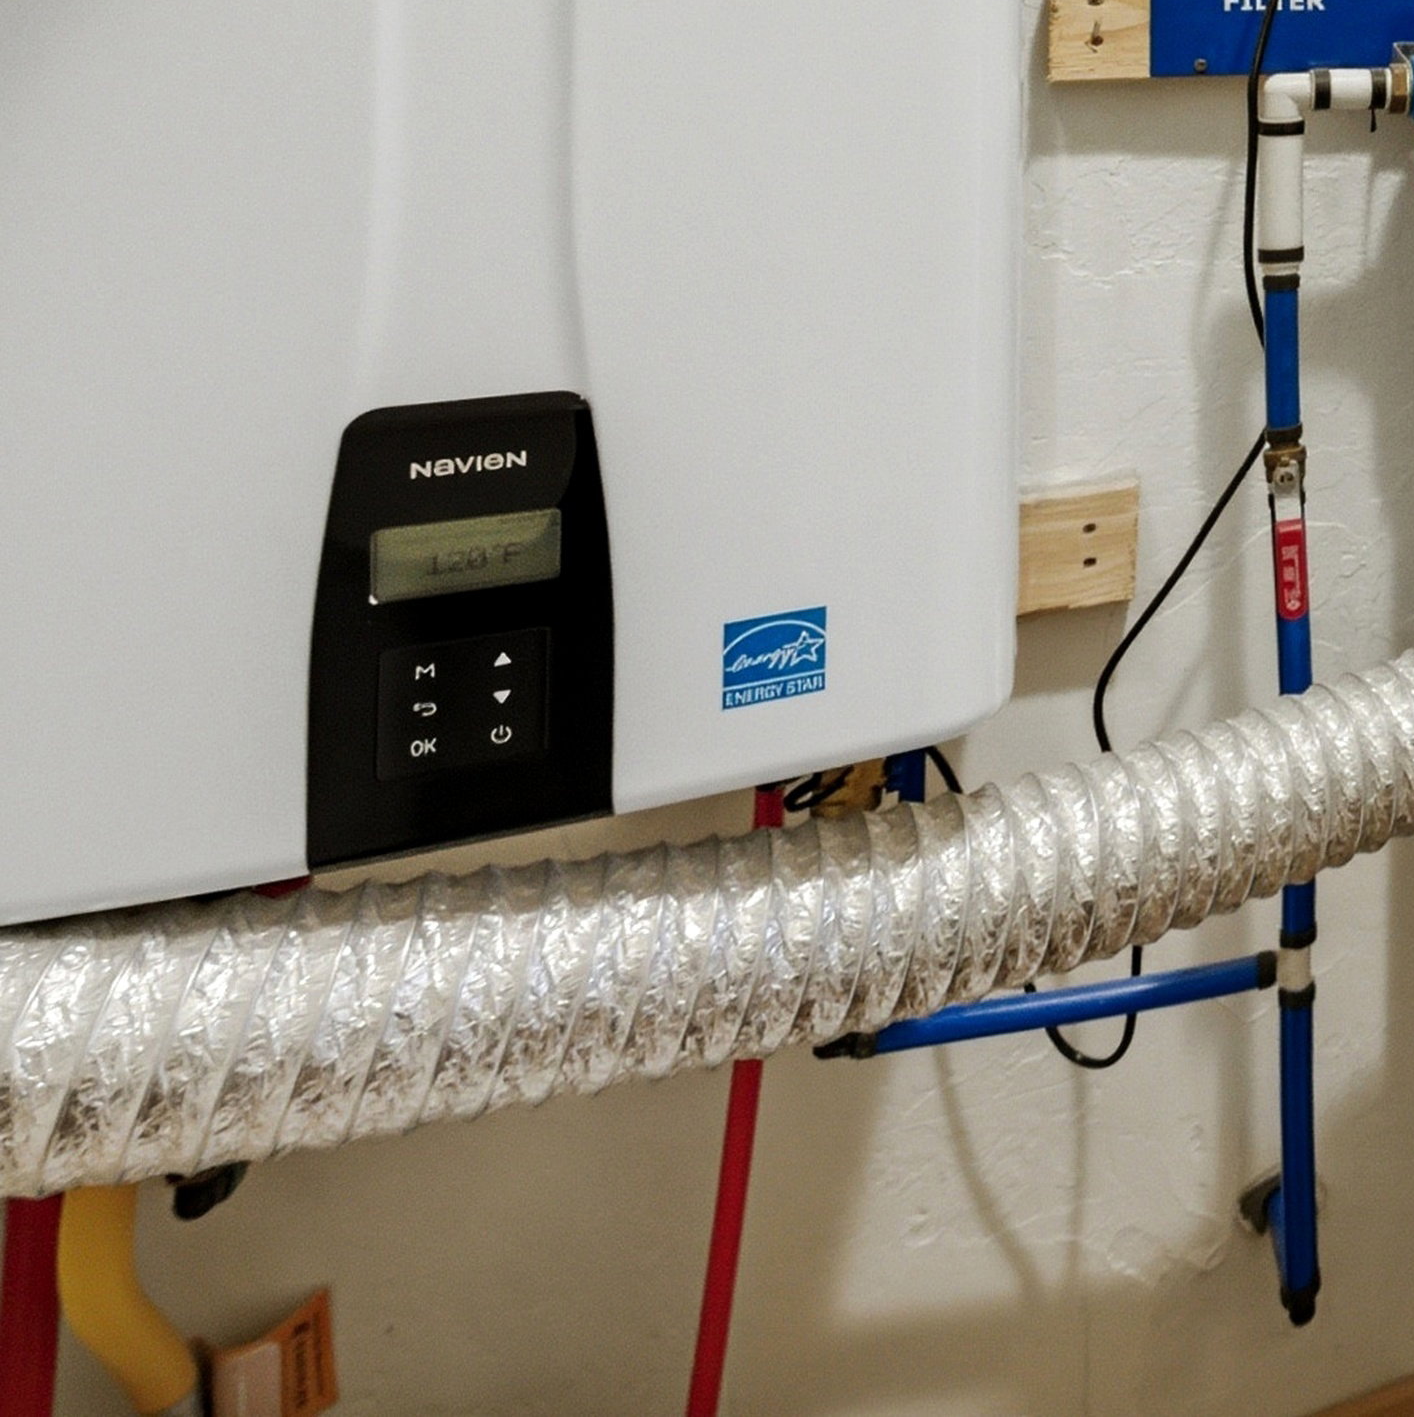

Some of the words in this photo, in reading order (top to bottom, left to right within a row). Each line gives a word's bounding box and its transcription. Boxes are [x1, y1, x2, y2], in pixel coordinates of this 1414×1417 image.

[415, 662, 436, 681] M
[725, 682, 784, 707] ENERGY
[410, 737, 437, 757] OK
